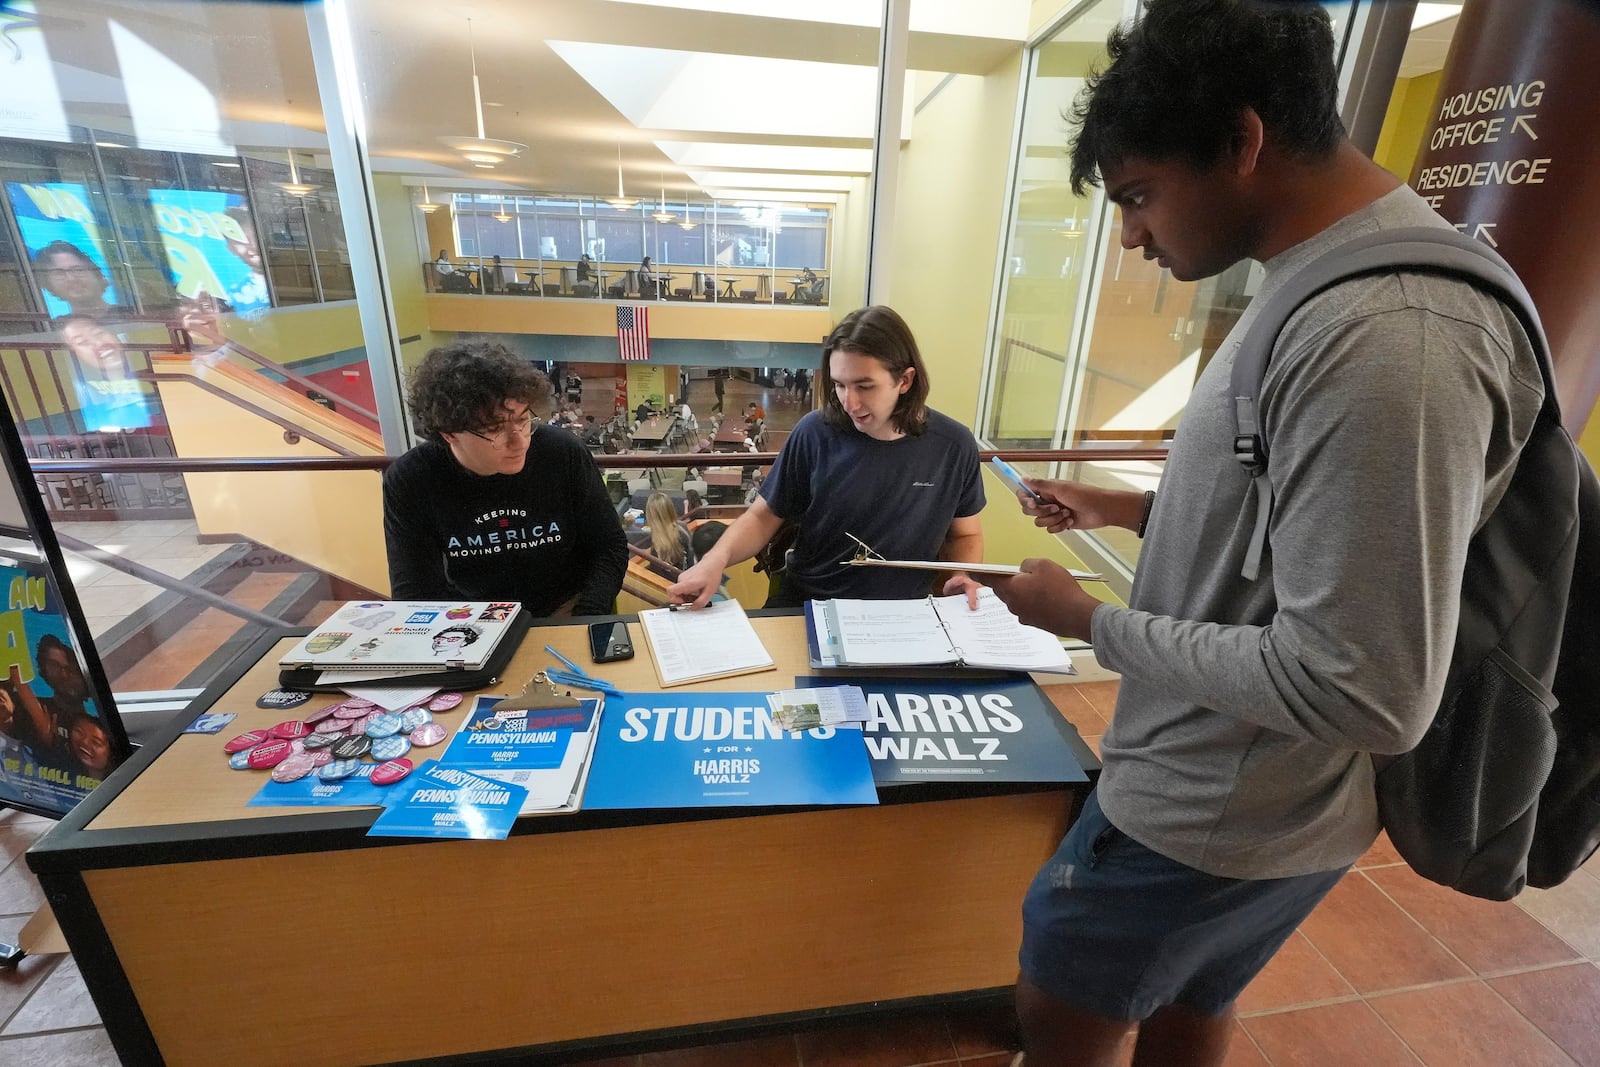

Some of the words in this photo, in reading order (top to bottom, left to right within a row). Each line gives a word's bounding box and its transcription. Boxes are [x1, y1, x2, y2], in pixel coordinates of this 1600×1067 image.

[1438, 80, 1546, 121] HOUSING
[1430, 117, 1505, 151] OFFICE
[1416, 158, 1552, 191] RESIDENCE
[475, 509, 527, 525] KEEPING
[448, 522, 560, 549] AMERICA
[450, 545, 501, 557] MOVING
[506, 534, 561, 550] FORWARD
[9, 575, 46, 611] AN
[859, 693, 1024, 733] ARRIS
[467, 731, 557, 744] PENNSYLVANIA
[717, 745, 738, 753] FOR
[863, 737, 1008, 761] WALZ
[425, 765, 507, 791] PNNSYLVAN
[693, 758, 760, 775] HARRIS
[311, 785, 343, 793] HARRIS
[703, 774, 750, 784] WALZ
[432, 812, 463, 821] HARR
